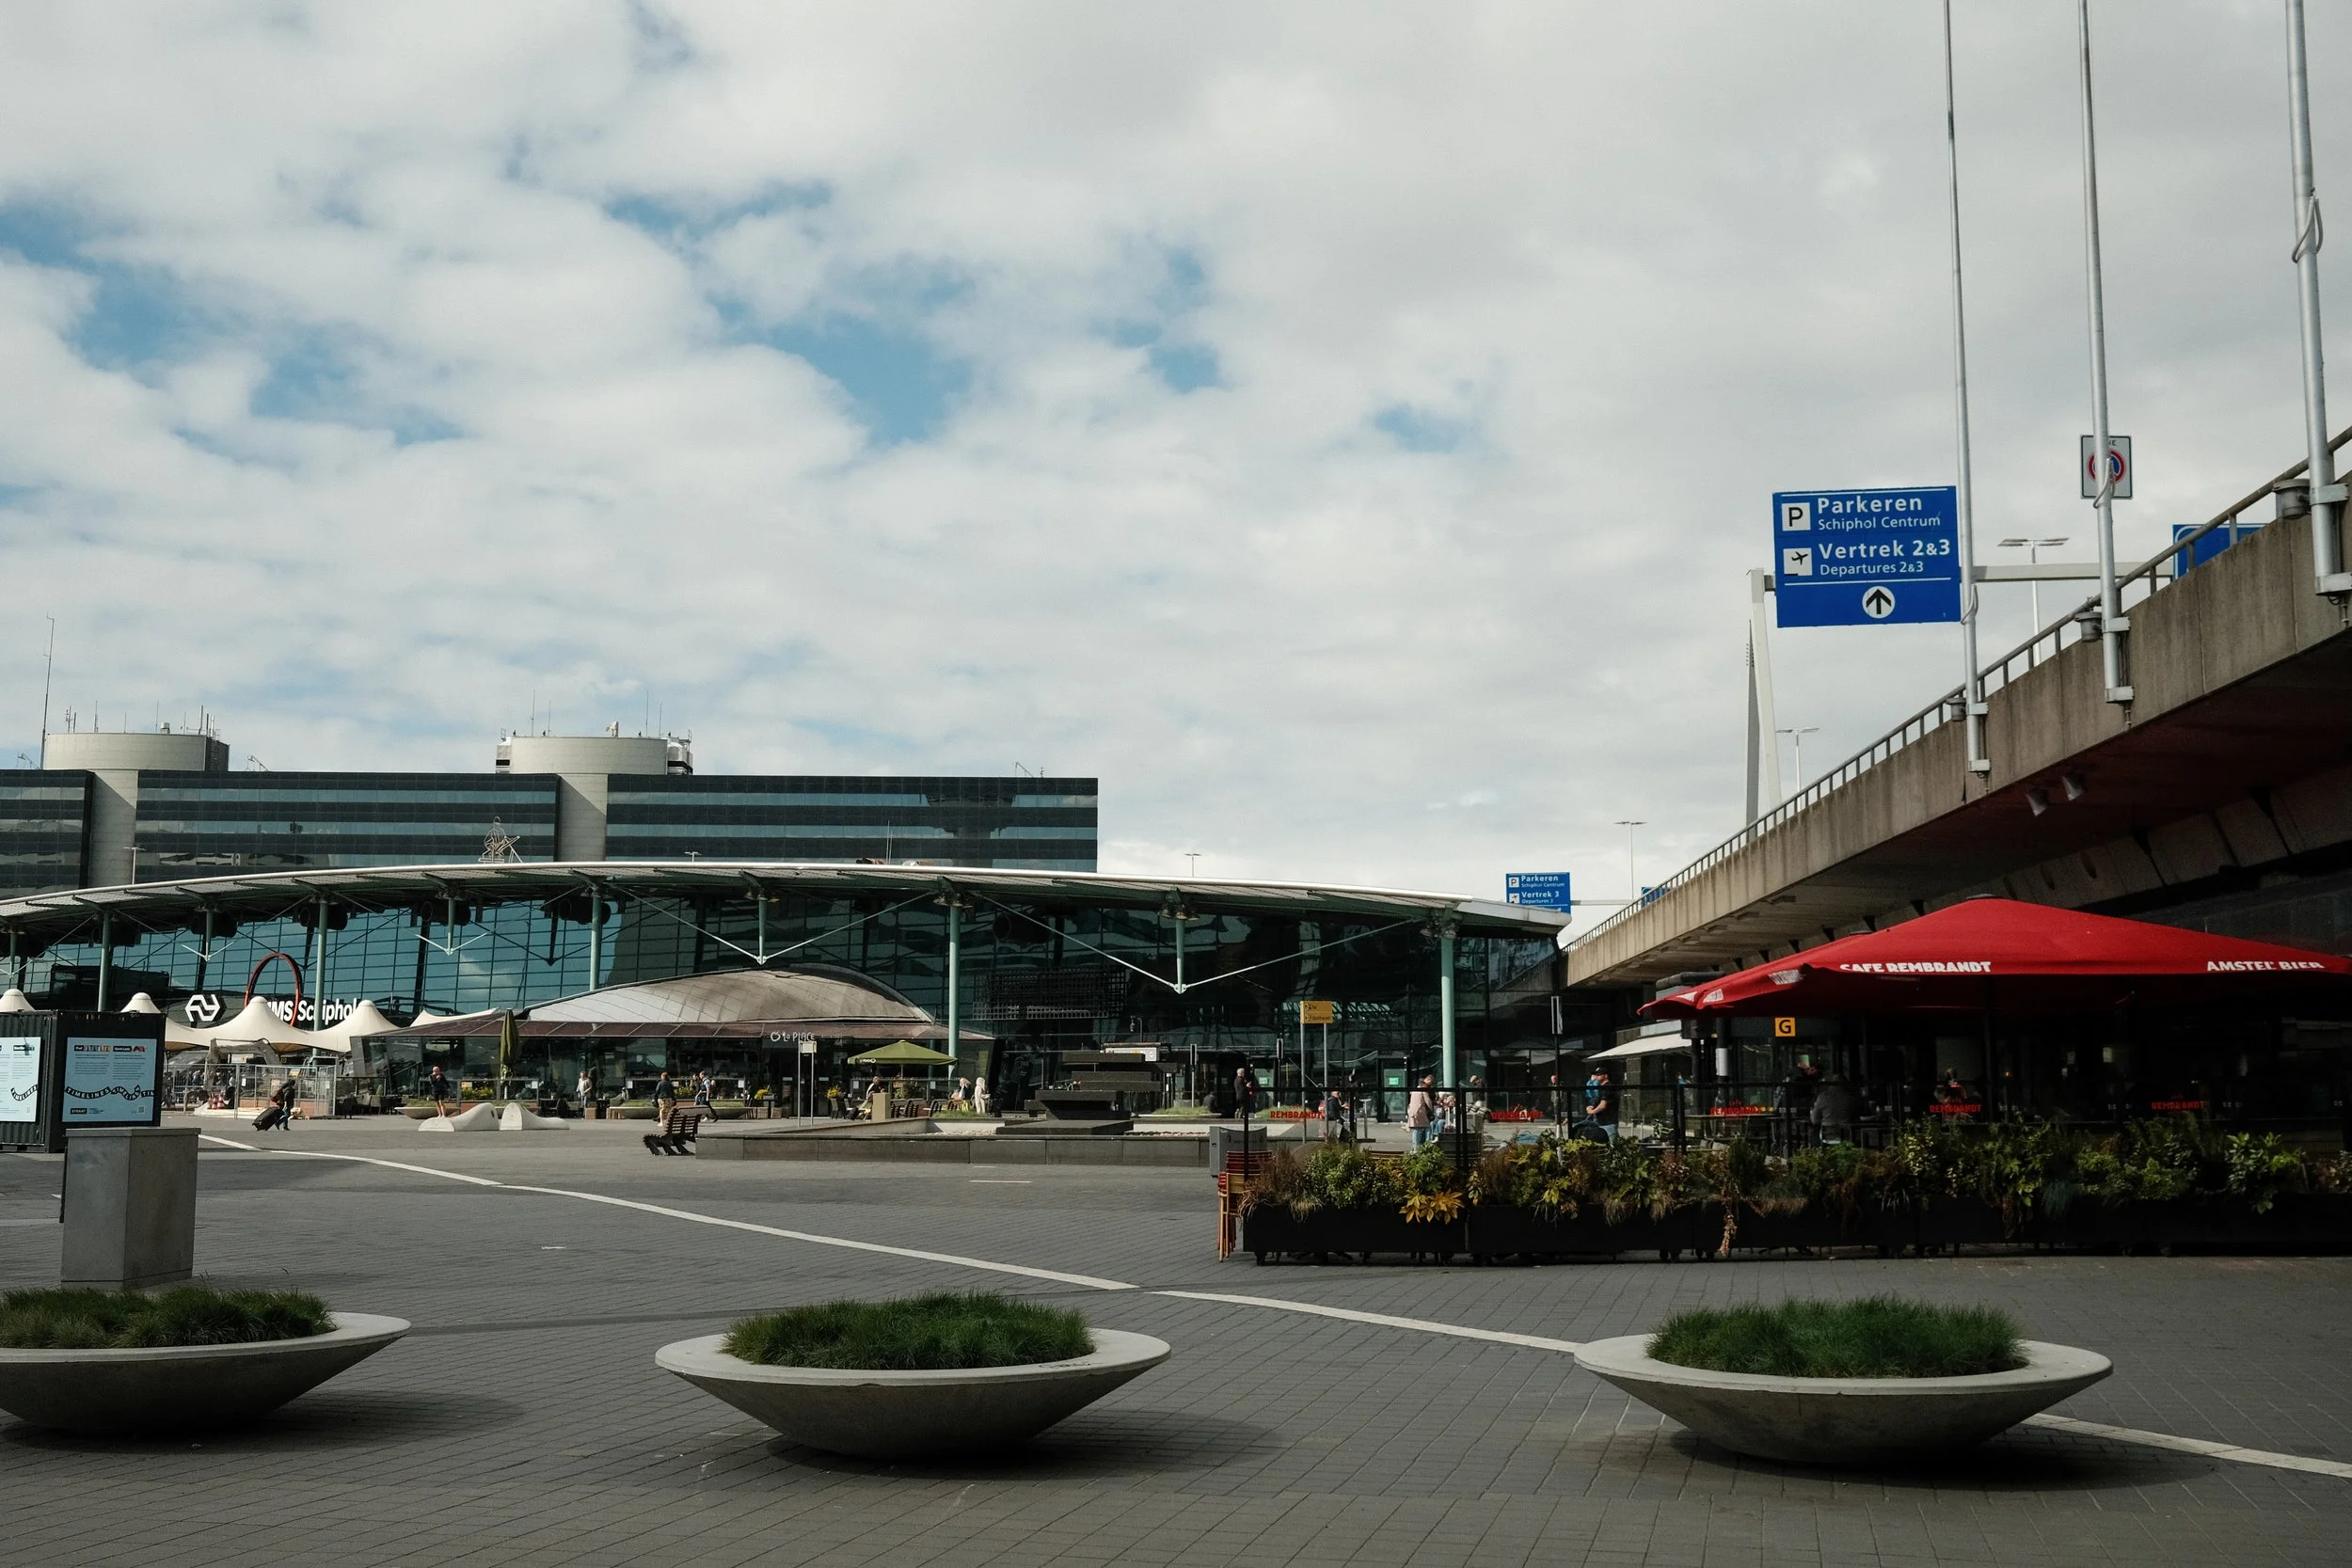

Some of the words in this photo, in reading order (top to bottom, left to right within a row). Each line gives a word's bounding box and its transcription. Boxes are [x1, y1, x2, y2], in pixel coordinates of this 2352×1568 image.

[1817, 495, 1922, 515] Parkeren
[1788, 506, 1804, 528] P
[1818, 516, 1876, 532] Schiphol
[1881, 515, 1941, 528] Centrum
[1819, 539, 1904, 560] Vertrek
[1912, 538, 1951, 557] 2&3
[1820, 562, 1897, 578] Departures
[1899, 561, 1925, 573] 2&3
[1839, 962, 1884, 973] CAFE
[1885, 961, 1992, 974] REMBRANDT
[2207, 961, 2275, 971] AMSTEL
[2278, 960, 2325, 971] BIER
[267, 1000, 294, 1022] MS
[296, 998, 357, 1025] Sciphol
[1779, 1019, 1791, 1035] G
[66, 1086, 110, 1099] TIMELINES
